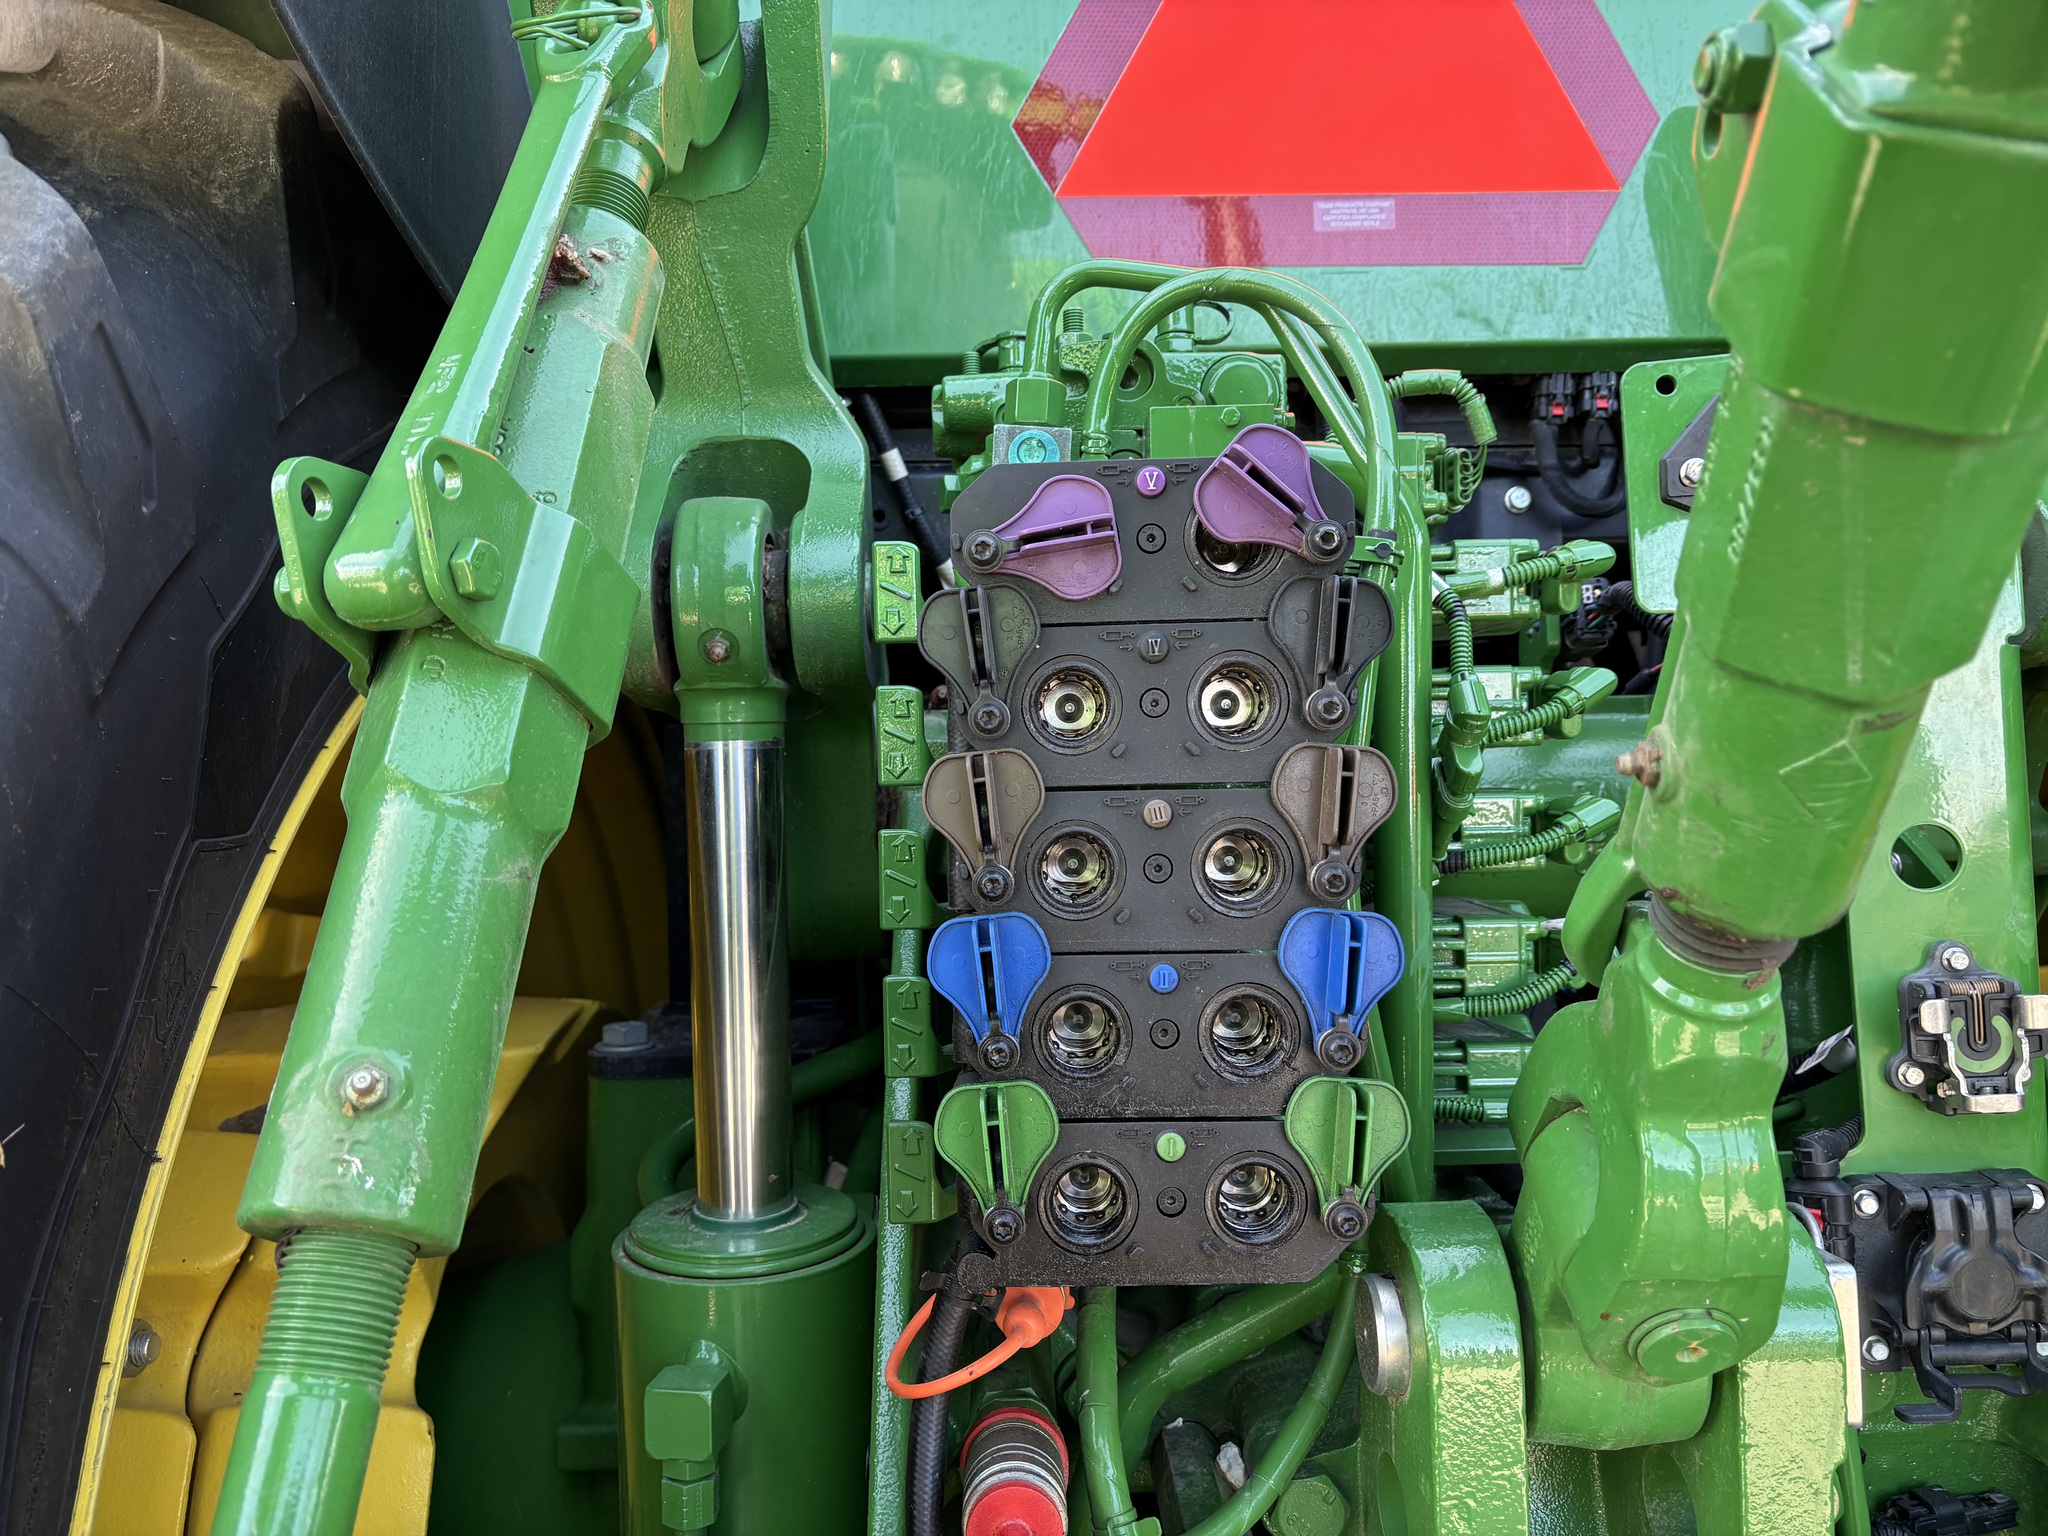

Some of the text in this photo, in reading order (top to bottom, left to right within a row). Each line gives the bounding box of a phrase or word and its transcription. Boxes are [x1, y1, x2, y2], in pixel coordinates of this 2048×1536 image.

[1144, 471, 1159, 490] V
[1147, 638, 1163, 656] IV
[1148, 803, 1168, 824] III
[1371, 792, 1380, 818] >PA6<
[1158, 970, 1170, 989] II
[1168, 1138, 1176, 1157] I
